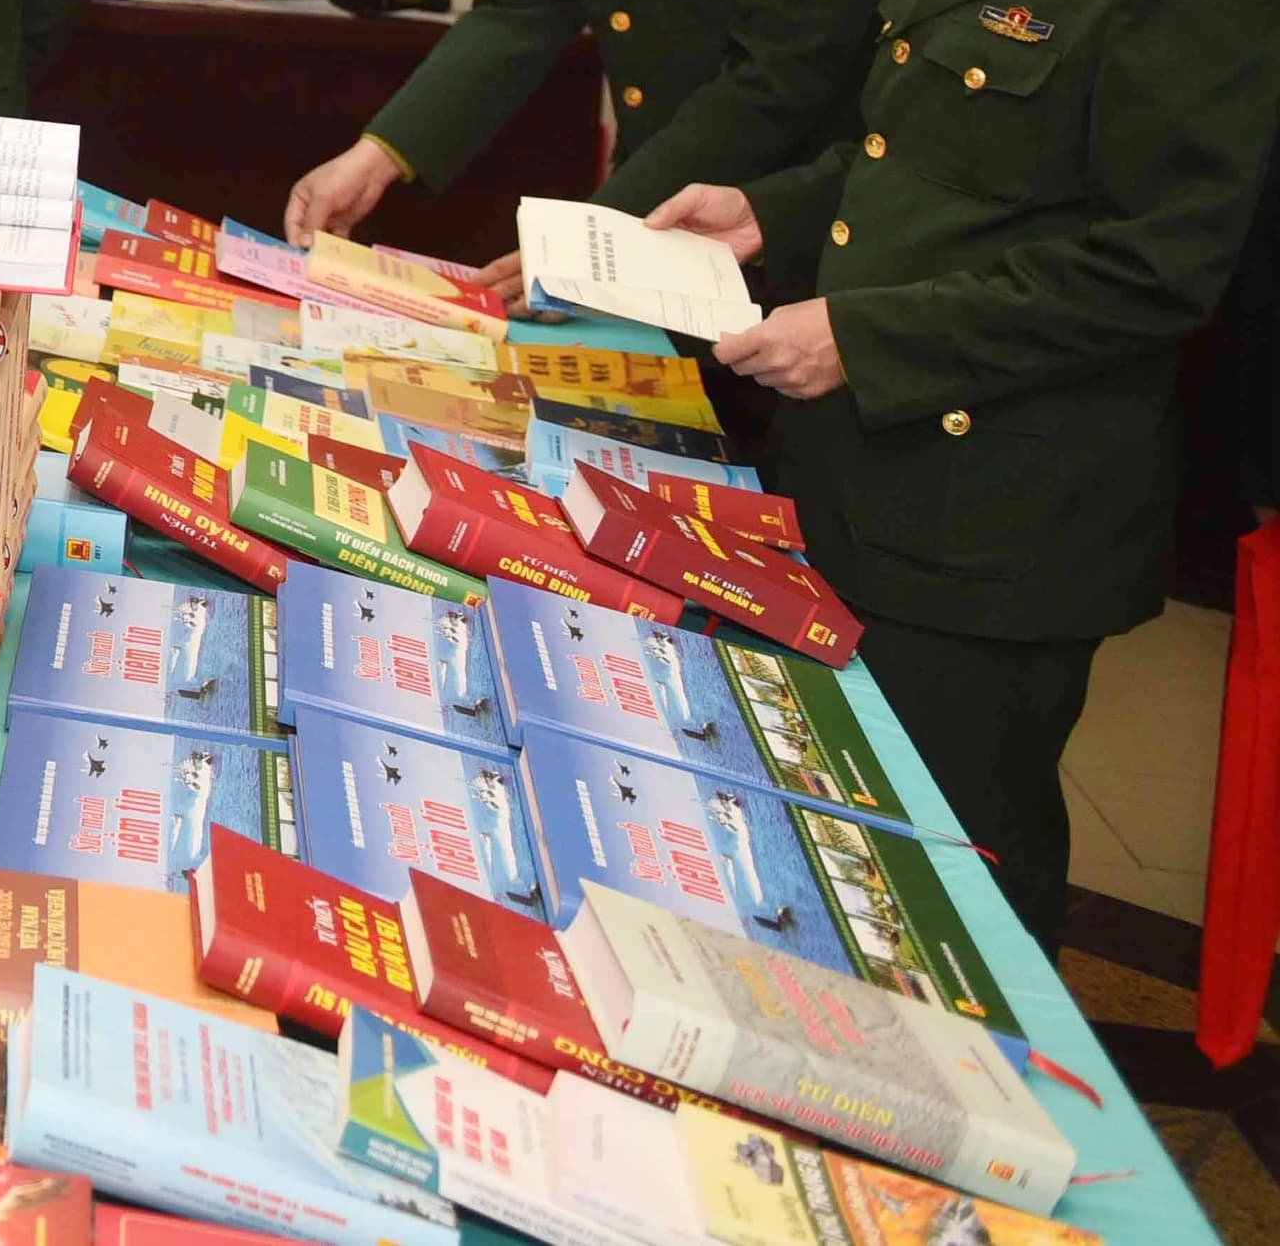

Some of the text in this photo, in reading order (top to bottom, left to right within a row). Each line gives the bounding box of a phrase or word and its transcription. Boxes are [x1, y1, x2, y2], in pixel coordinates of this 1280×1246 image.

[144, 485, 250, 553] PHÁO BINH
[161, 513, 196, 537] ĐIỂN
[335, 530, 448, 587] TỪ ĐIỂN BÁCH KHOA
[338, 548, 436, 596] BIÊN PHÒNG
[521, 554, 578, 583] TỪ ĐIỂN
[498, 557, 591, 603] CÔNG BINH
[702, 570, 754, 599] TỪ ĐIỂN
[122, 626, 162, 646] tin
[387, 634, 427, 658] tin
[601, 654, 644, 679] tin
[115, 789, 161, 815] tin
[420, 800, 468, 831] tin
[659, 819, 708, 852] tin
[21, 904, 39, 928] NAM
[335, 895, 378, 978] HẬU CẦN
[378, 936, 414, 992] QUÂN
[798, 1075, 894, 1127] TỪ ĐIỂN
[903, 1143, 945, 1170] NAM
